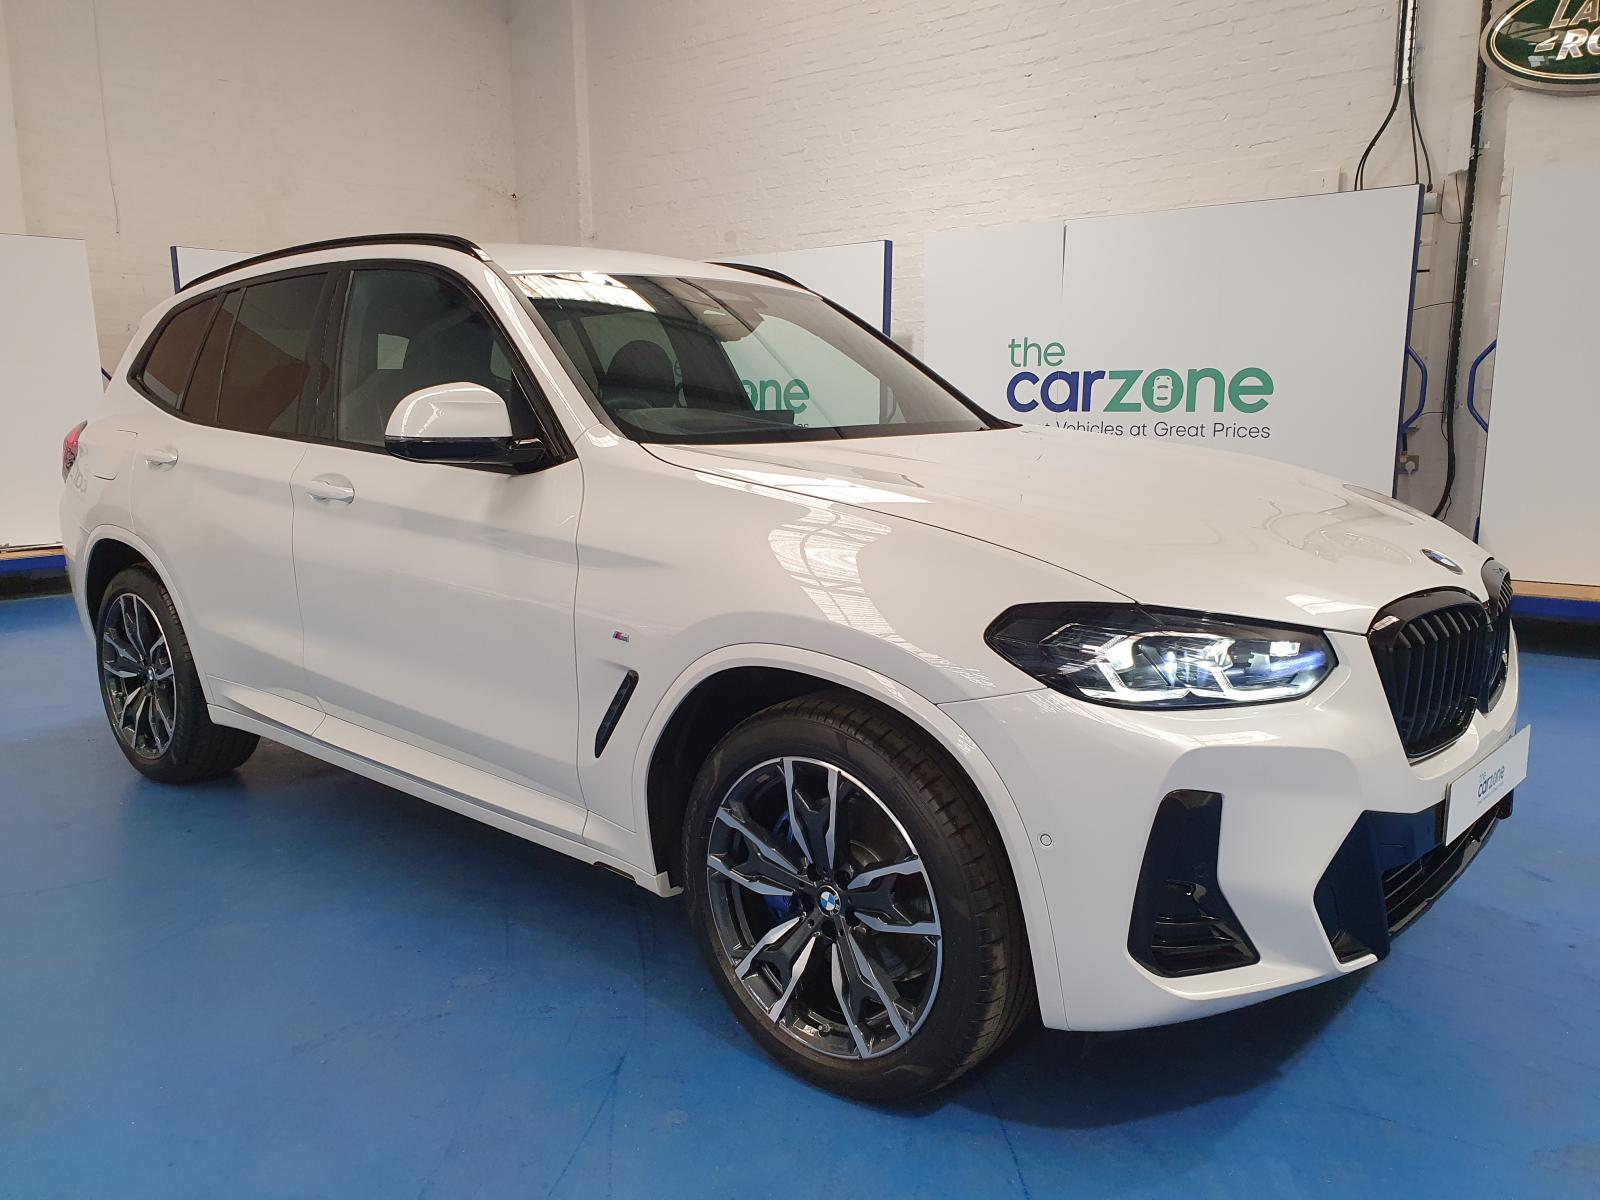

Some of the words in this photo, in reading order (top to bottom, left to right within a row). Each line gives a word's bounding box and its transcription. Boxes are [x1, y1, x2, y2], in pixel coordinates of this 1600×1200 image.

[1008, 337, 1066, 367] the
[1006, 367, 1274, 413] carzone
[1129, 423, 1147, 437] at
[1154, 421, 1206, 437] Great
[1213, 422, 1271, 438] Prices
